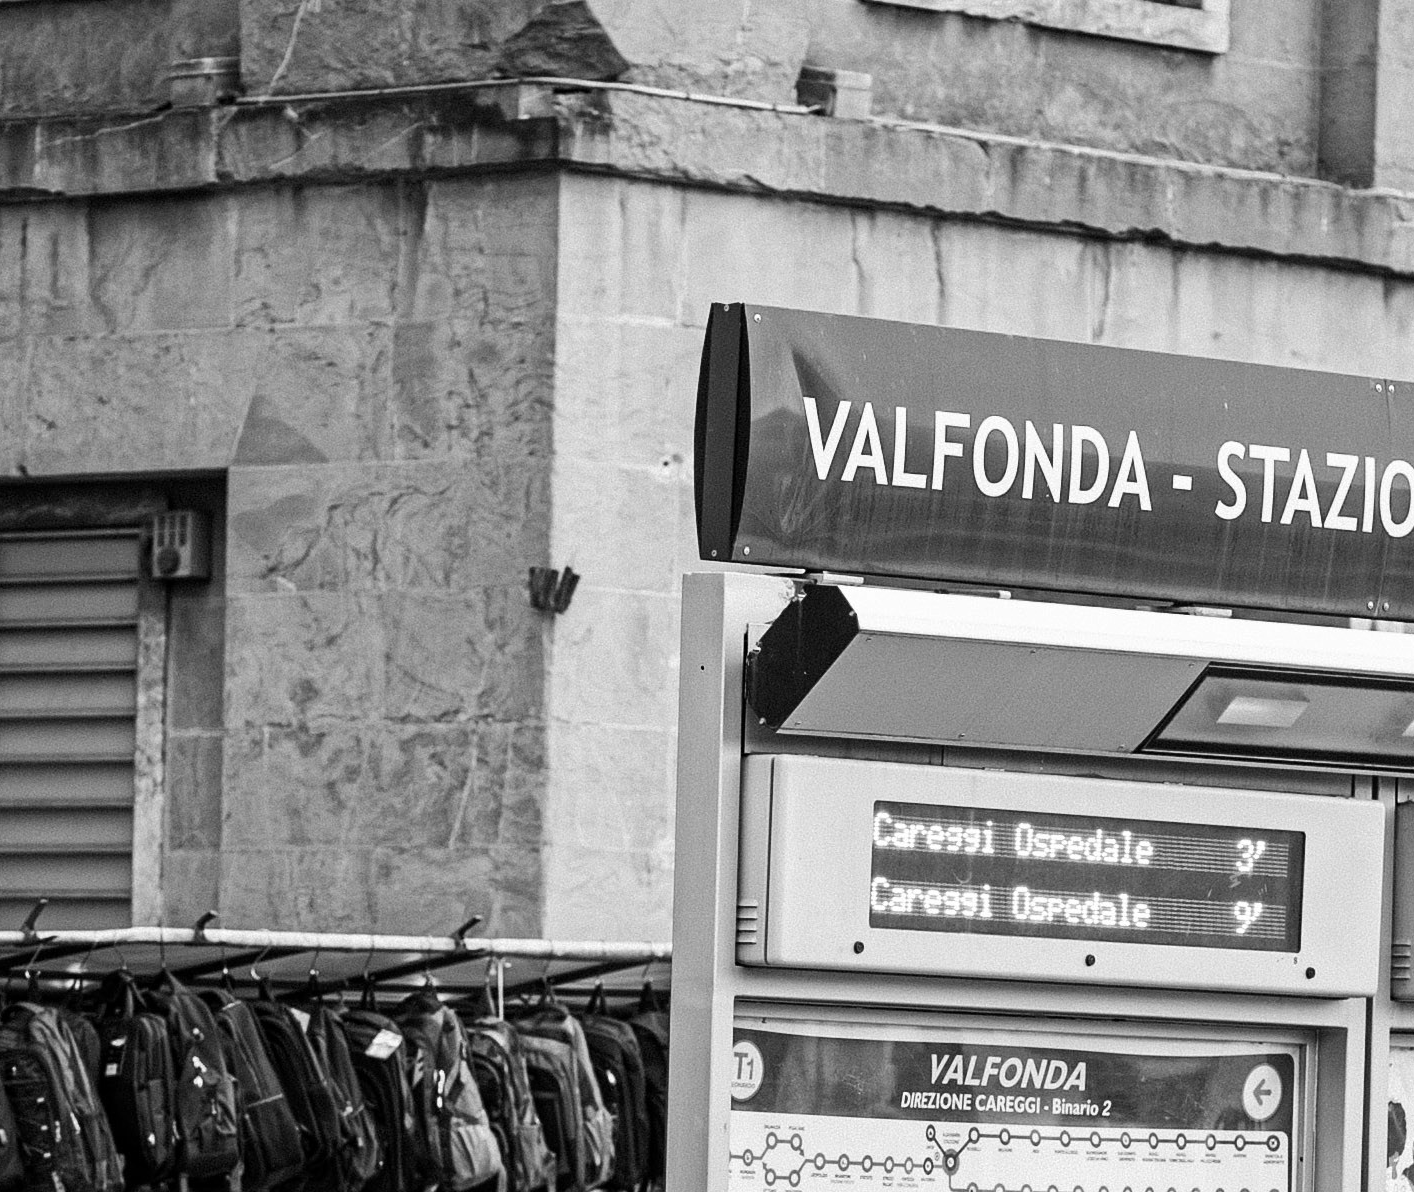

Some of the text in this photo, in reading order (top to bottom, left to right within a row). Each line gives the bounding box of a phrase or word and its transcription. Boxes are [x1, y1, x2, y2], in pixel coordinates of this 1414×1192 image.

[803, 396, 1153, 512] VALFONDA
[1172, 475, 1193, 491] -
[873, 811, 1266, 873] Careggi Ospedale 3'
[871, 876, 1263, 934] Careggi Ospedale 9'
[734, 1052, 754, 1080] T1
[930, 1053, 1087, 1091] VALFONDA
[901, 1092, 972, 1111] DIREZIONE
[975, 1094, 1041, 1114] CAREGGI
[1052, 1098, 1099, 1116] Binario
[1101, 1100, 1112, 1117] 2
